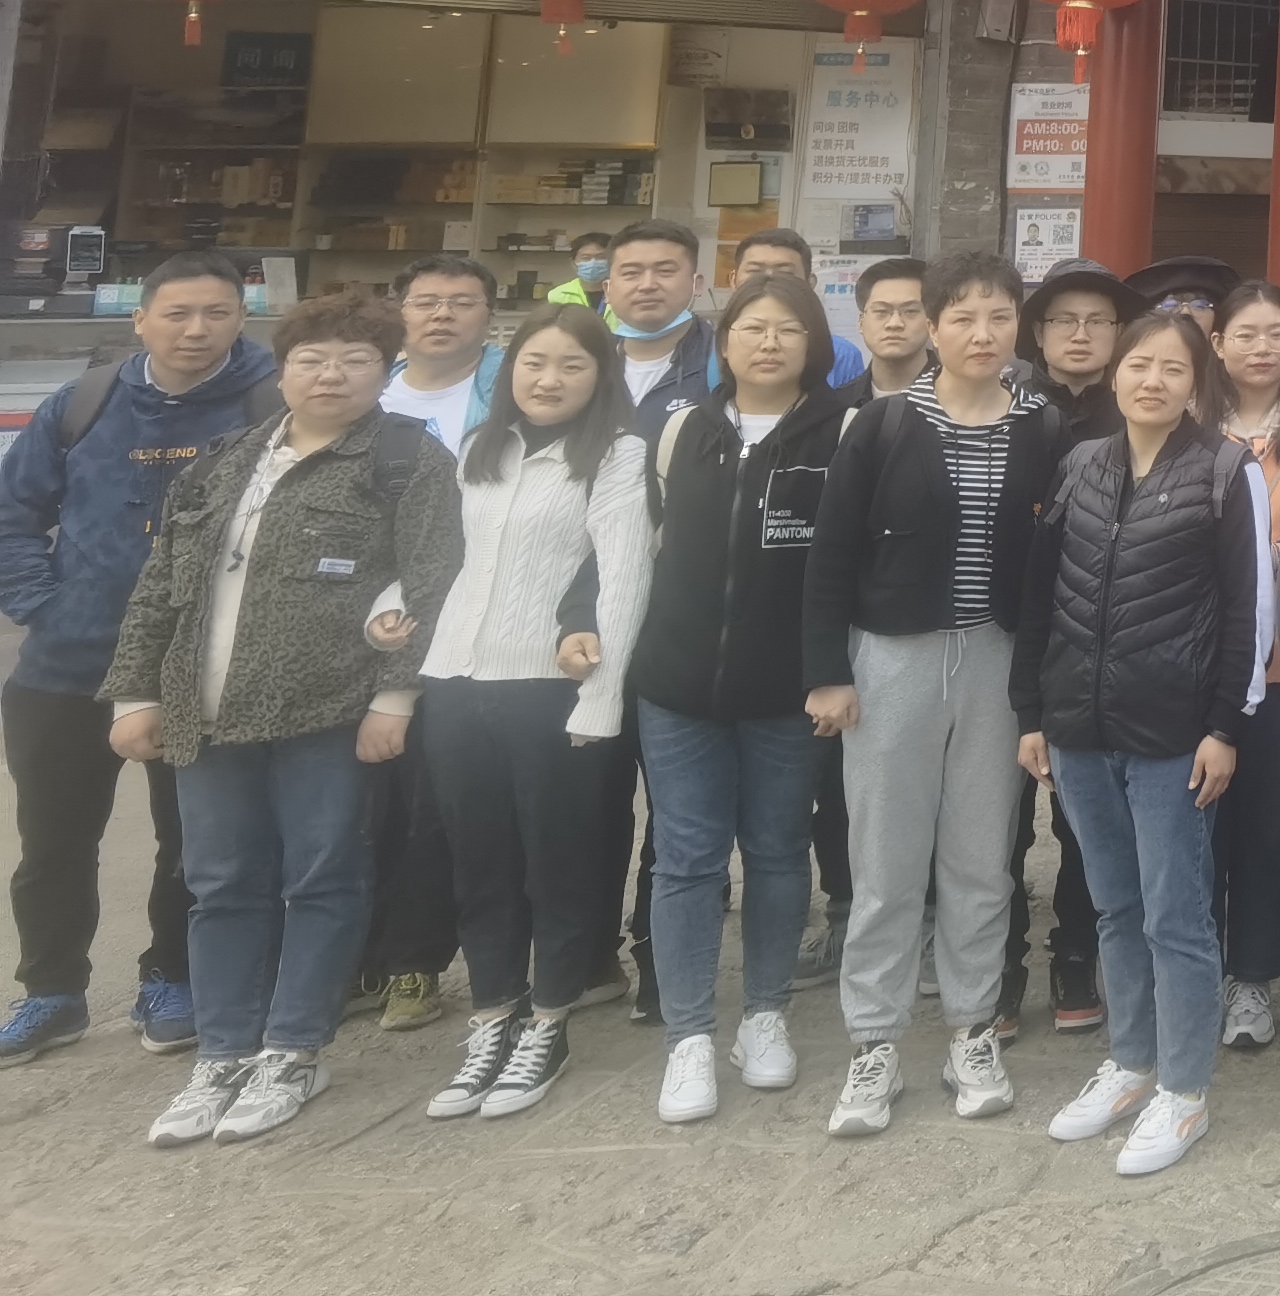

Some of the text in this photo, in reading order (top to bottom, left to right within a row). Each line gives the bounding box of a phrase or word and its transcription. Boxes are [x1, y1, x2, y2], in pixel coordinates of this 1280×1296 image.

[826, 90, 899, 108] 服务中心
[812, 139, 855, 151] 发票开具
[813, 156, 890, 168] 退换货无忧服务
[1034, 213, 1063, 221] POLICE
